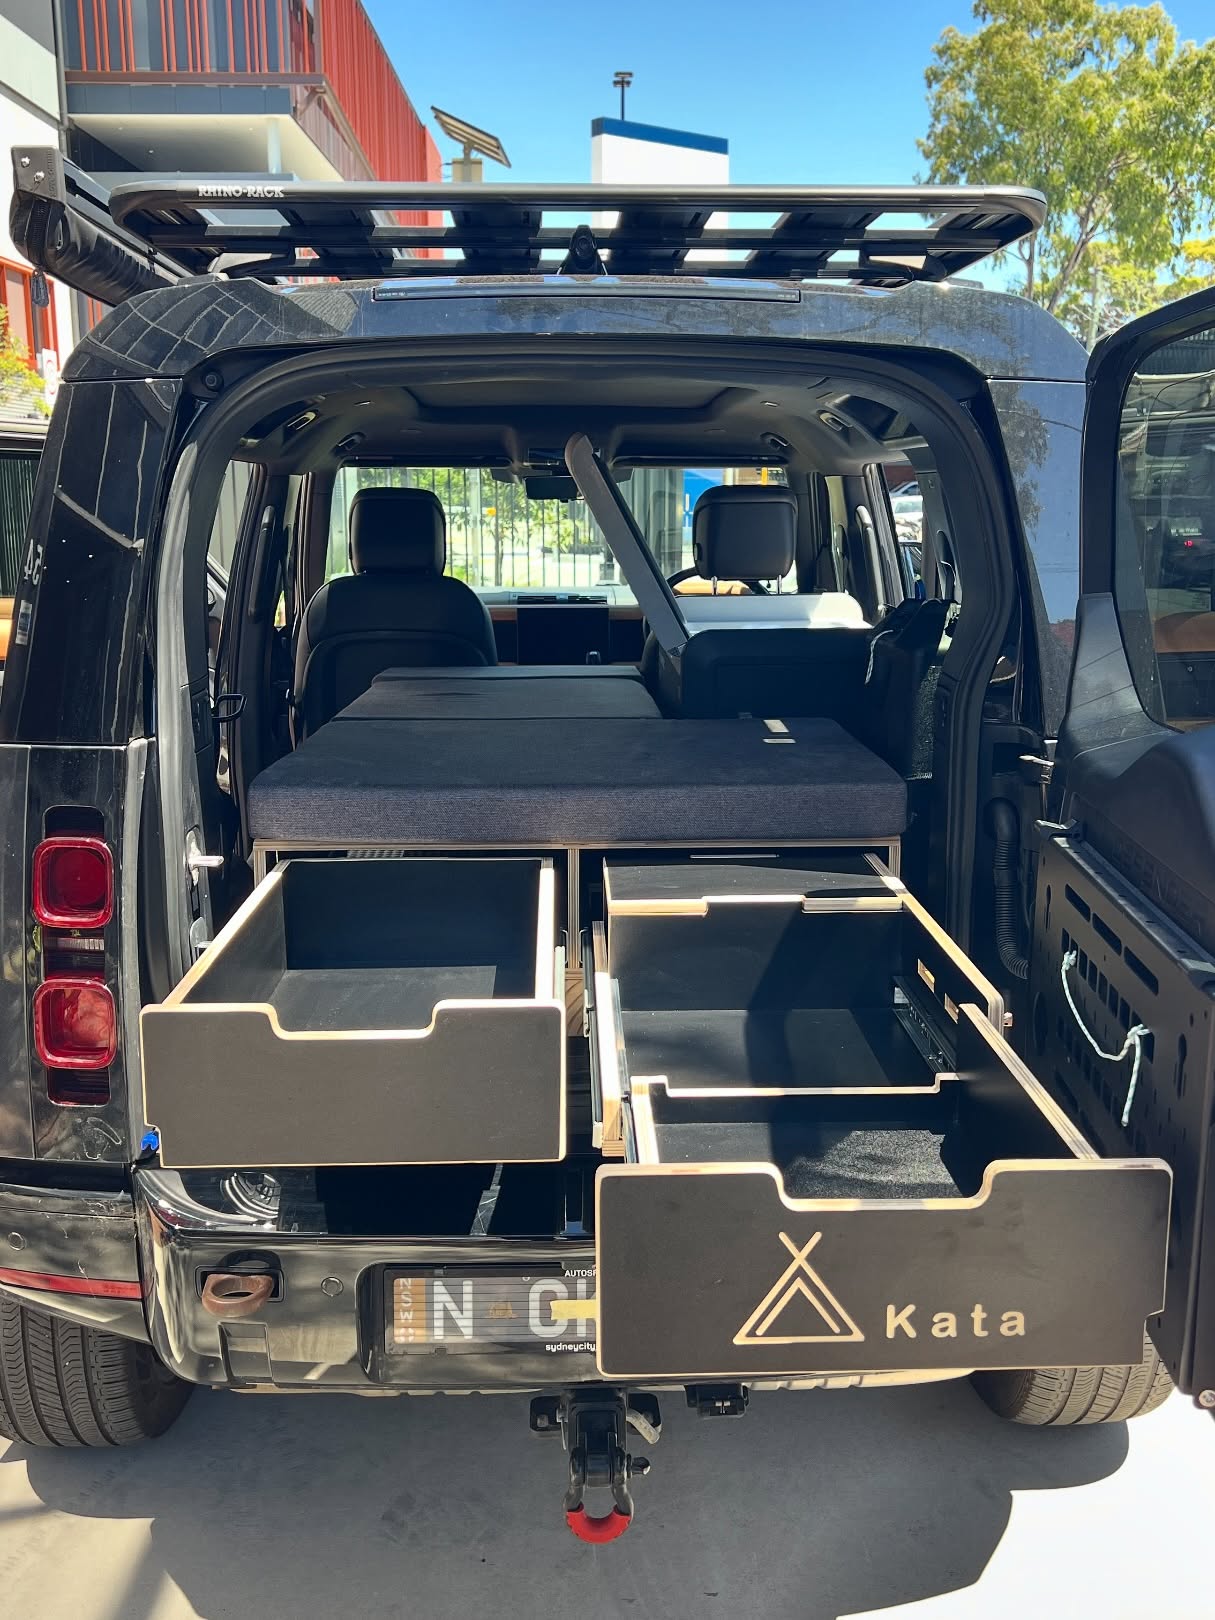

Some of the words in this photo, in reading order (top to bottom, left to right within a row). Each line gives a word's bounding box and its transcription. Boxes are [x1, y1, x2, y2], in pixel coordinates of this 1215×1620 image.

[198, 185, 284, 198] RHINO-RACK
[399, 1278, 414, 1323] NSW
[433, 1280, 473, 1340] N
[886, 1303, 1026, 1339] Kata
